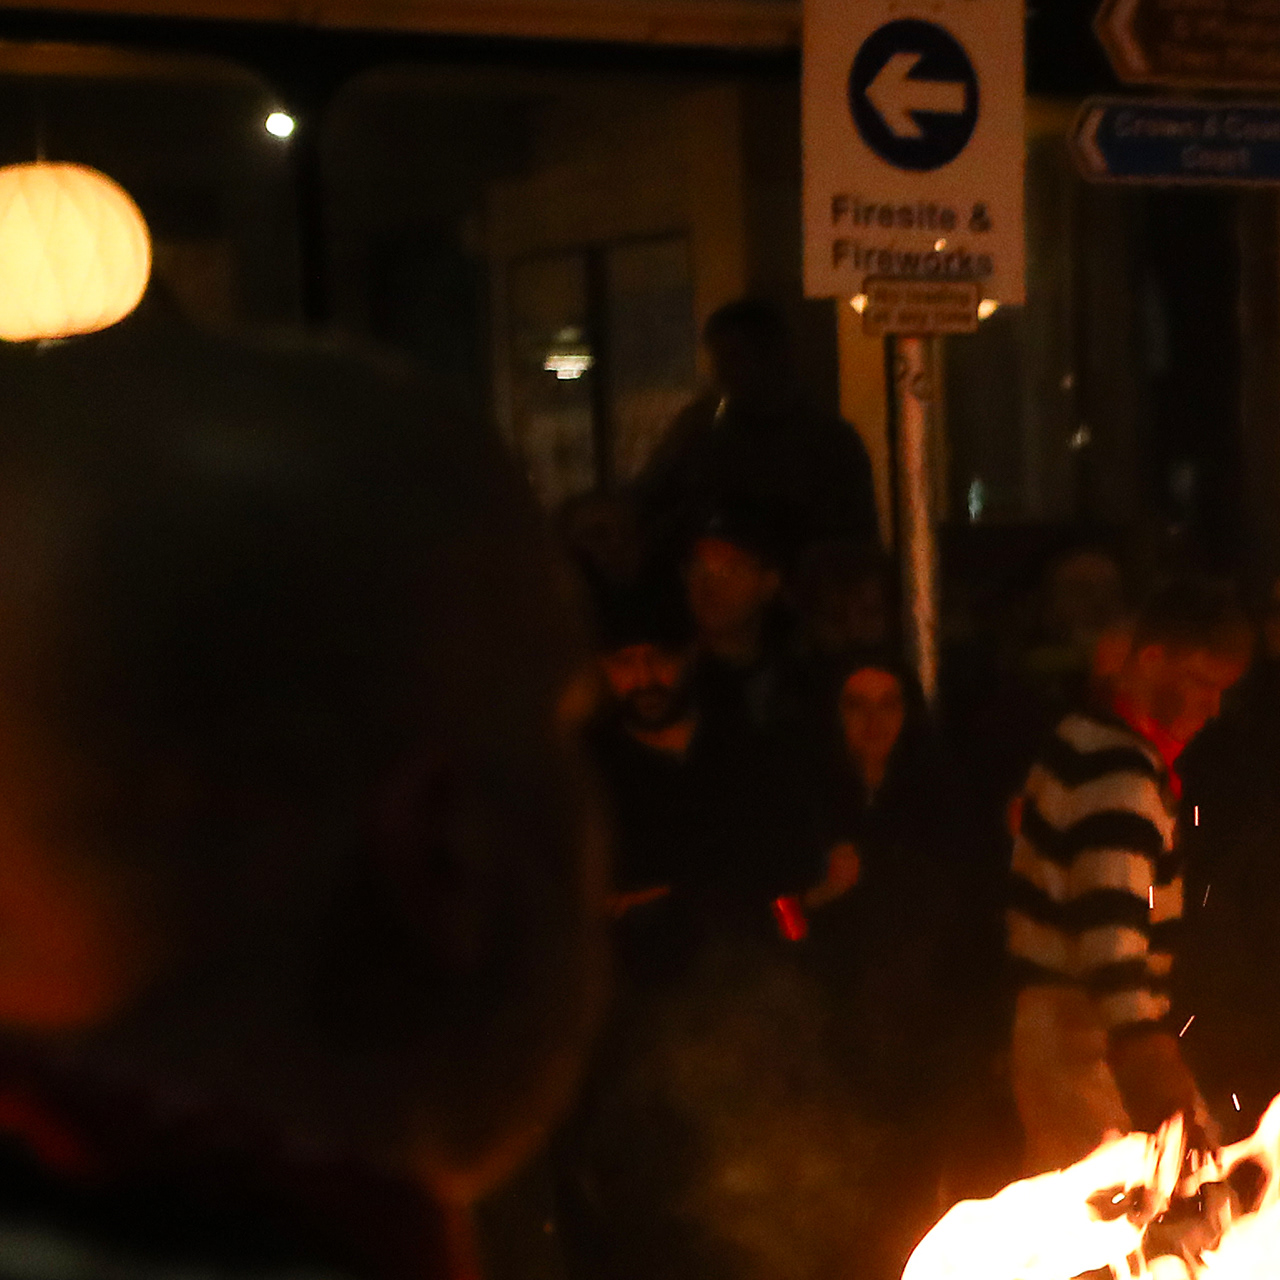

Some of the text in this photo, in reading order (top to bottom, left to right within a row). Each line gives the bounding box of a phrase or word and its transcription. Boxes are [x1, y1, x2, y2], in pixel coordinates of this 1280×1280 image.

[830, 194, 992, 233] Firesite &
[831, 238, 995, 277] Fireworks
